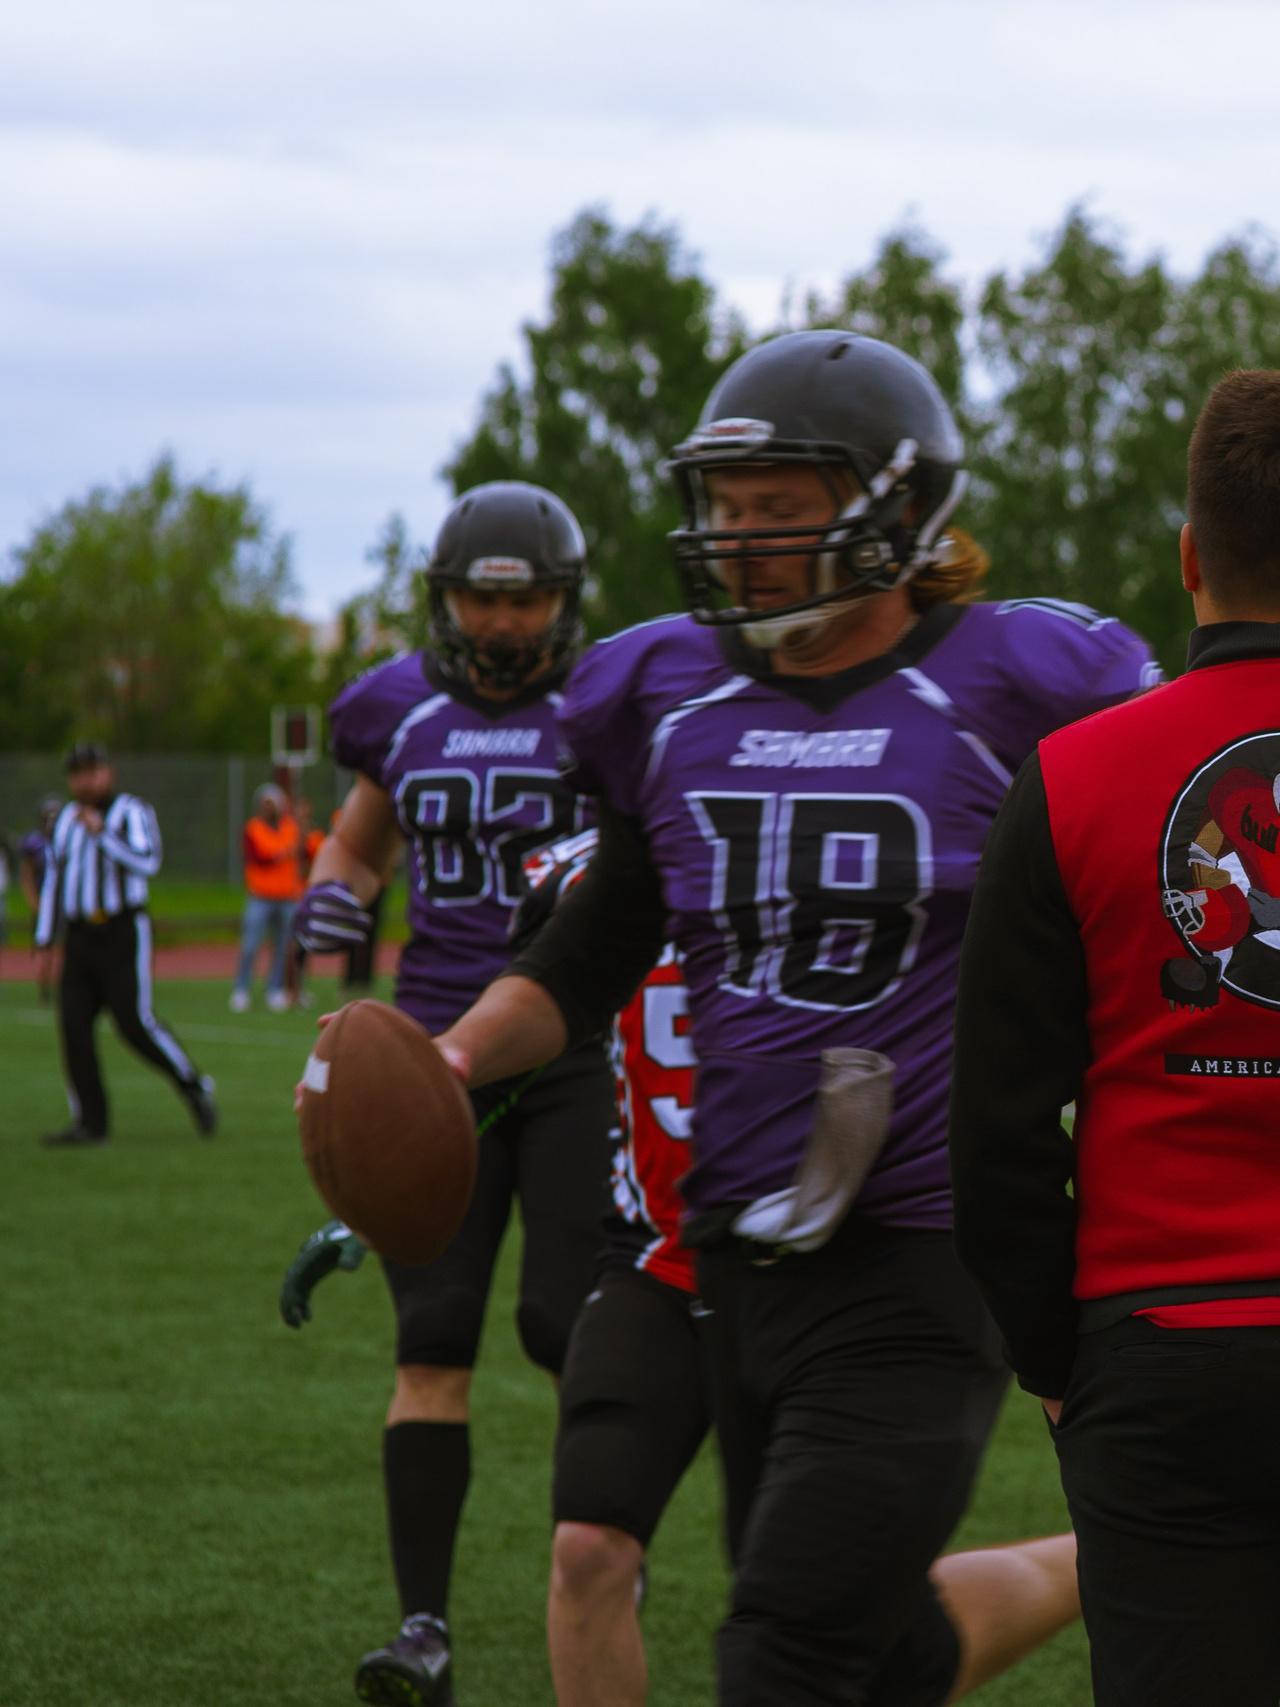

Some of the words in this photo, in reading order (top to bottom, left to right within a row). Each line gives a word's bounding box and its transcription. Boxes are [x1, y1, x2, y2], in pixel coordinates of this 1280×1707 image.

[395, 766, 584, 908] 82
[1240, 803, 1278, 855] bull
[682, 790, 935, 1012] 18
